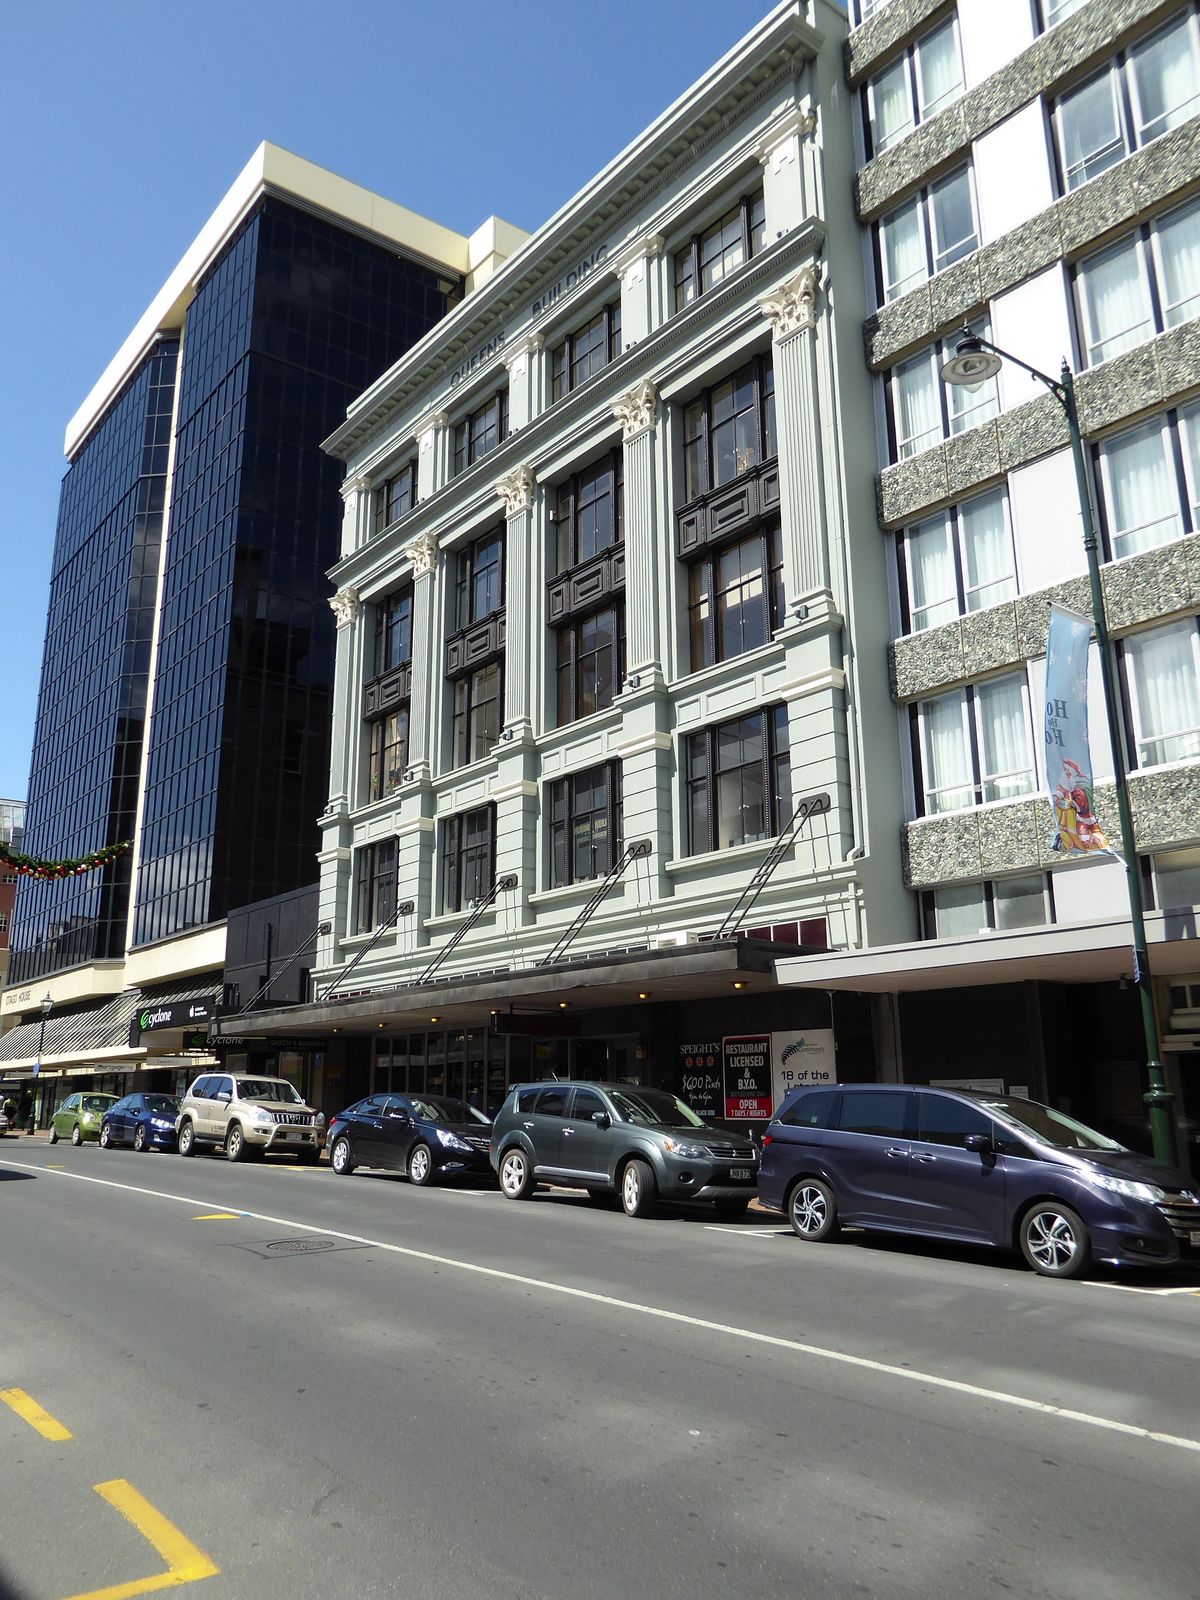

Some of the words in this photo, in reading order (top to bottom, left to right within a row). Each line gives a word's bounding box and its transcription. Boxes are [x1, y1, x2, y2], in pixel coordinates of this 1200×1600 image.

[532, 245, 609, 316] BUILDING
[19, 990, 31, 1003] HOUSE
[148, 1009, 172, 1028] cyclone
[206, 1036, 243, 1046] cyclone
[680, 1043, 720, 1054] SPEIGHT'S
[725, 1042, 768, 1055] RESTAURANT
[730, 1056, 764, 1067] LICENSED
[743, 1067, 750, 1078] &
[781, 1071, 794, 1081] 18
[797, 1070, 808, 1081] of
[811, 1070, 829, 1080] the
[738, 1078, 758, 1090] B.Y.O.
[739, 1099, 758, 1109] OPEN
[749, 1109, 767, 1117] NIGHTS
